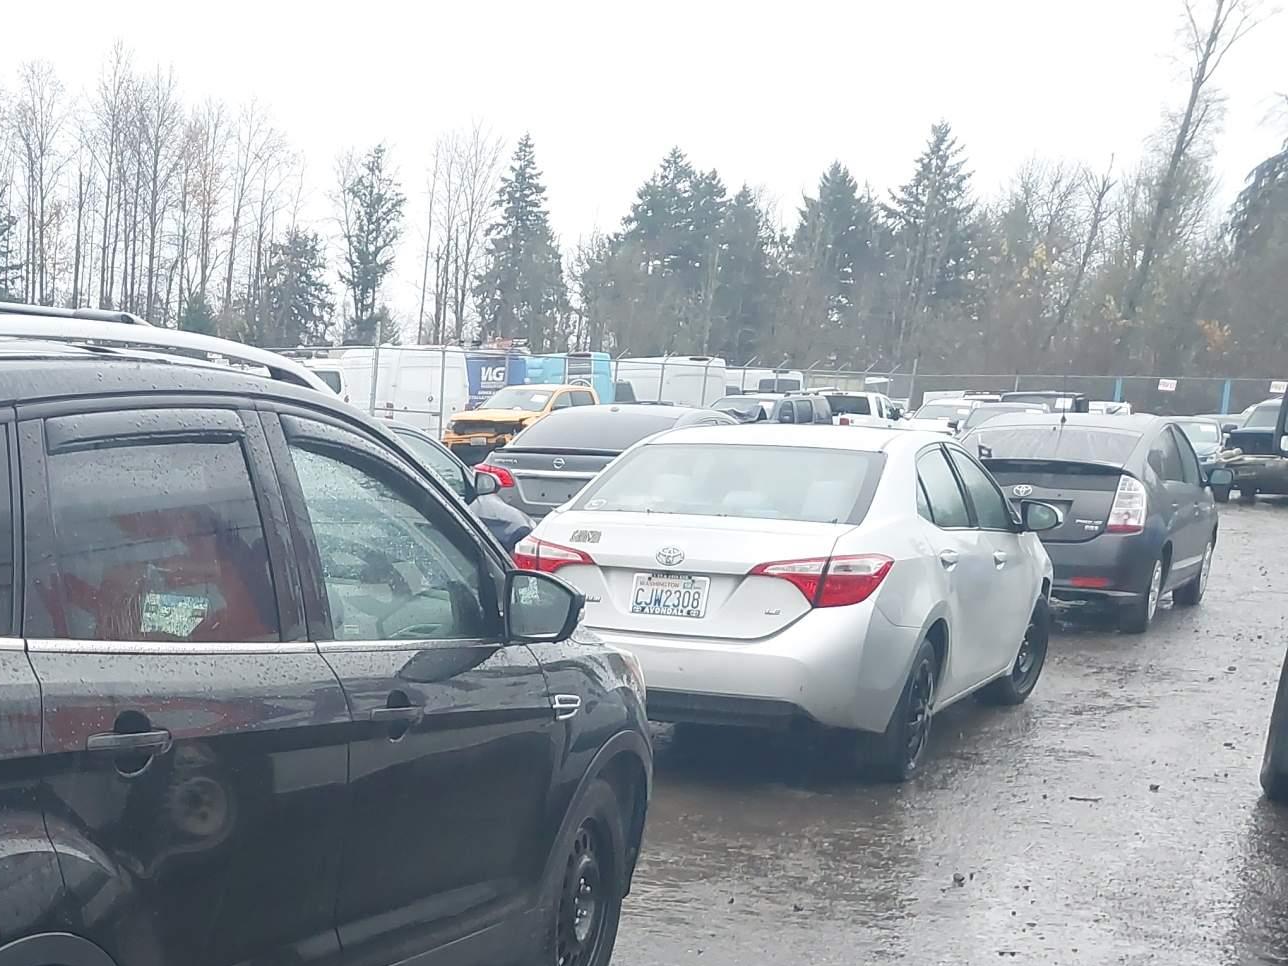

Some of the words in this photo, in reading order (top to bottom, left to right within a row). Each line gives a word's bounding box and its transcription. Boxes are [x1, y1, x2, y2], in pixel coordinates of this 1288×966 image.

[639, 580, 680, 589] WASHINGTON
[635, 587, 701, 610] CJW2308
[643, 606, 689, 617] AVONDALE
